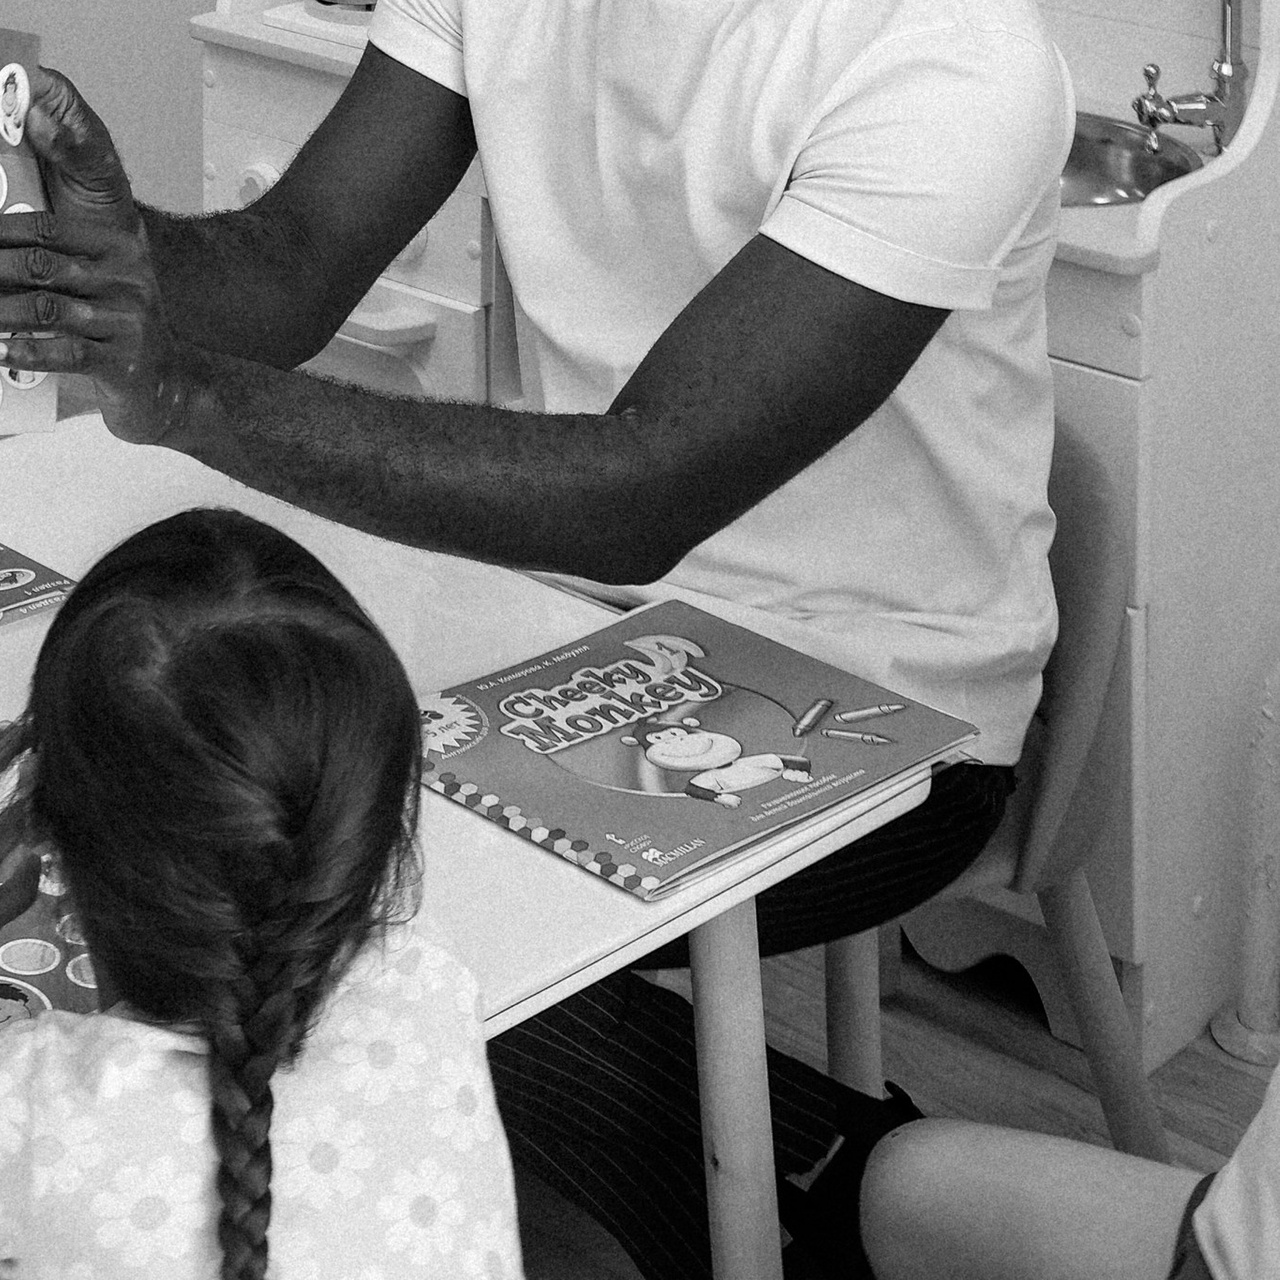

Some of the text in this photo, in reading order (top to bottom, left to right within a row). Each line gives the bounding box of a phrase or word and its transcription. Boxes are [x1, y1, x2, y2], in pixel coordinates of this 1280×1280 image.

[503, 662, 652, 719] Cheeky
[507, 669, 720, 752] Monkey
[652, 837, 706, 868] MACMILLAN
